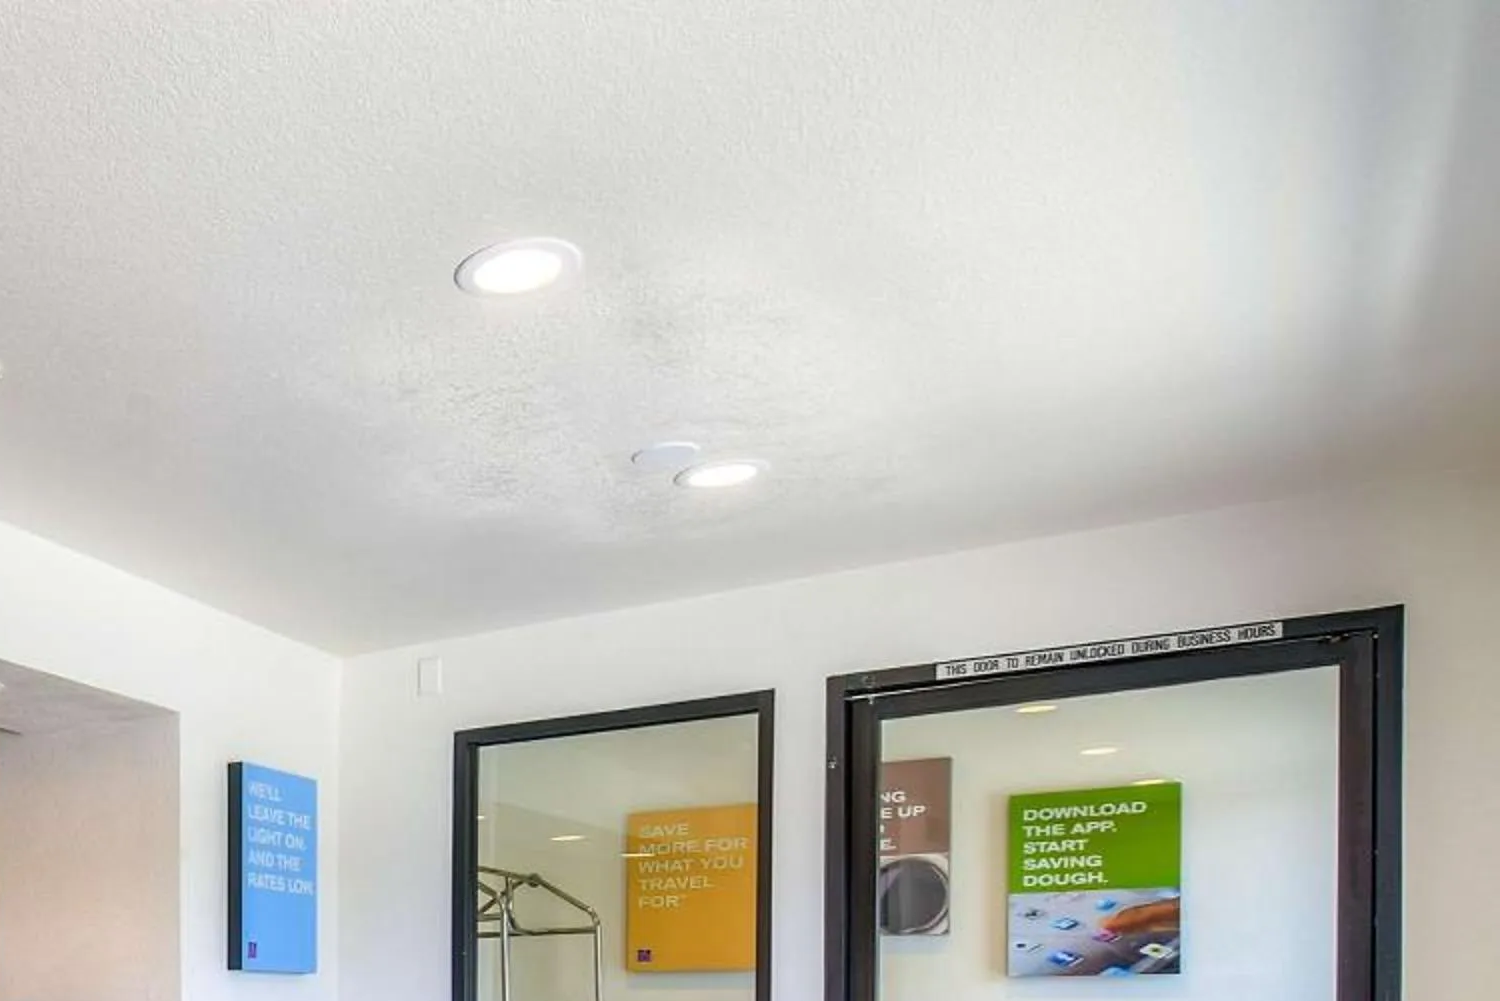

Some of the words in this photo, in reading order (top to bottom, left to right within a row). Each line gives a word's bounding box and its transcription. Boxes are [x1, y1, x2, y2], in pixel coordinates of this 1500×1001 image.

[945, 664, 967, 676] THIS
[973, 660, 999, 673] DOOR
[1006, 657, 1019, 669] TO
[1025, 651, 1065, 667] REMAIN
[1070, 643, 1125, 661] UNLOCKED
[1131, 638, 1171, 655] DURING
[1177, 629, 1231, 649] BUSINESS
[1237, 624, 1276, 641] HOURS
[248, 804, 286, 826] LEAVE
[288, 812, 311, 831] THE
[898, 805, 926, 817] UP
[1023, 801, 1147, 821] DOWNLOAD
[248, 826, 282, 846] LIGHT
[639, 823, 689, 839] SAVE
[1023, 823, 1066, 837] THE
[1070, 820, 1118, 835] APP.
[640, 840, 702, 856] MORE
[705, 837, 749, 851] FOR
[1023, 839, 1090, 855] START
[248, 848, 275, 868] AND
[276, 854, 301, 873] THE
[639, 859, 695, 873] WHAT
[701, 856, 744, 869] YOU
[1023, 855, 1104, 871] SAVING
[247, 871, 286, 893] RATES
[639, 876, 716, 891] TRAVEL
[1023, 871, 1109, 887] DOUGH.
